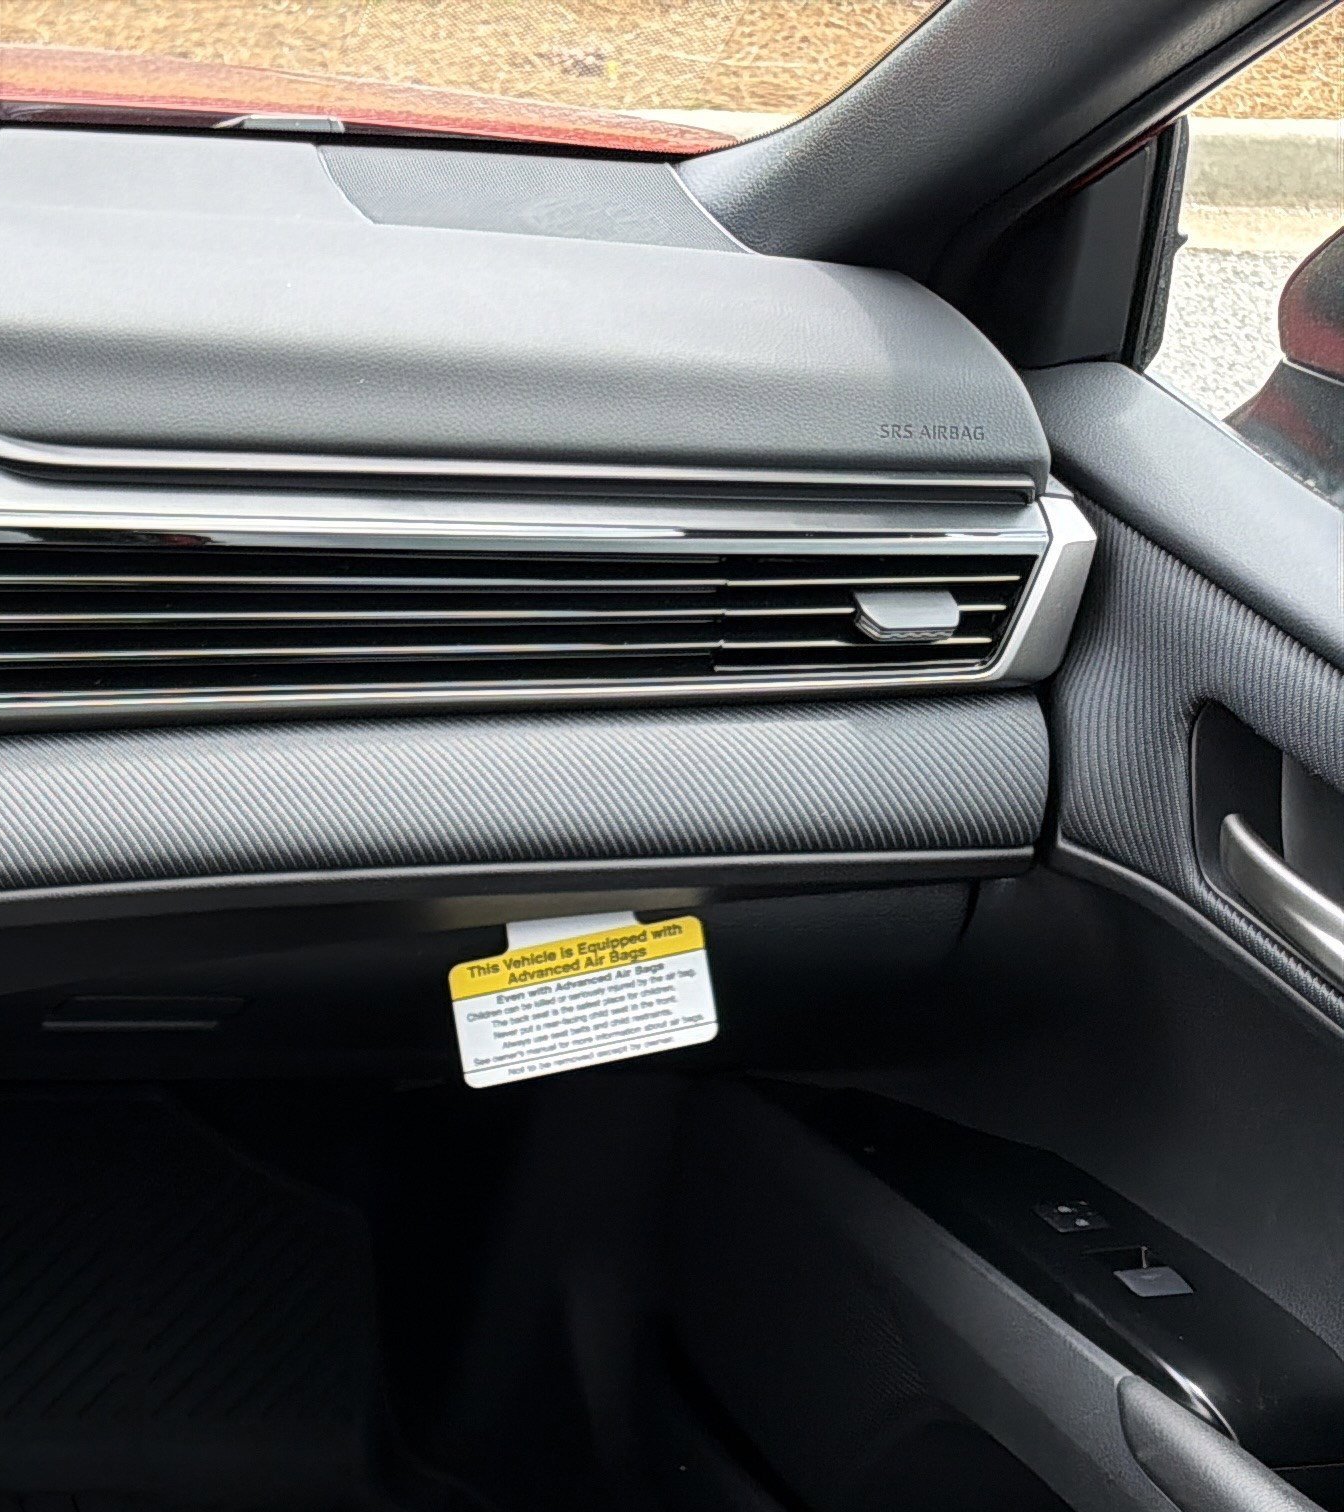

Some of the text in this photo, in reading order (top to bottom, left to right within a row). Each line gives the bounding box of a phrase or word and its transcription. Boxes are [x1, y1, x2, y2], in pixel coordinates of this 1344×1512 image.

[880, 424, 985, 441] SRS AIRBAG
[466, 924, 683, 978] This Vehicle is Equipped with
[508, 947, 647, 985] Advanced Air Bags
[496, 963, 664, 1005] Even with Advanced Air Bags
